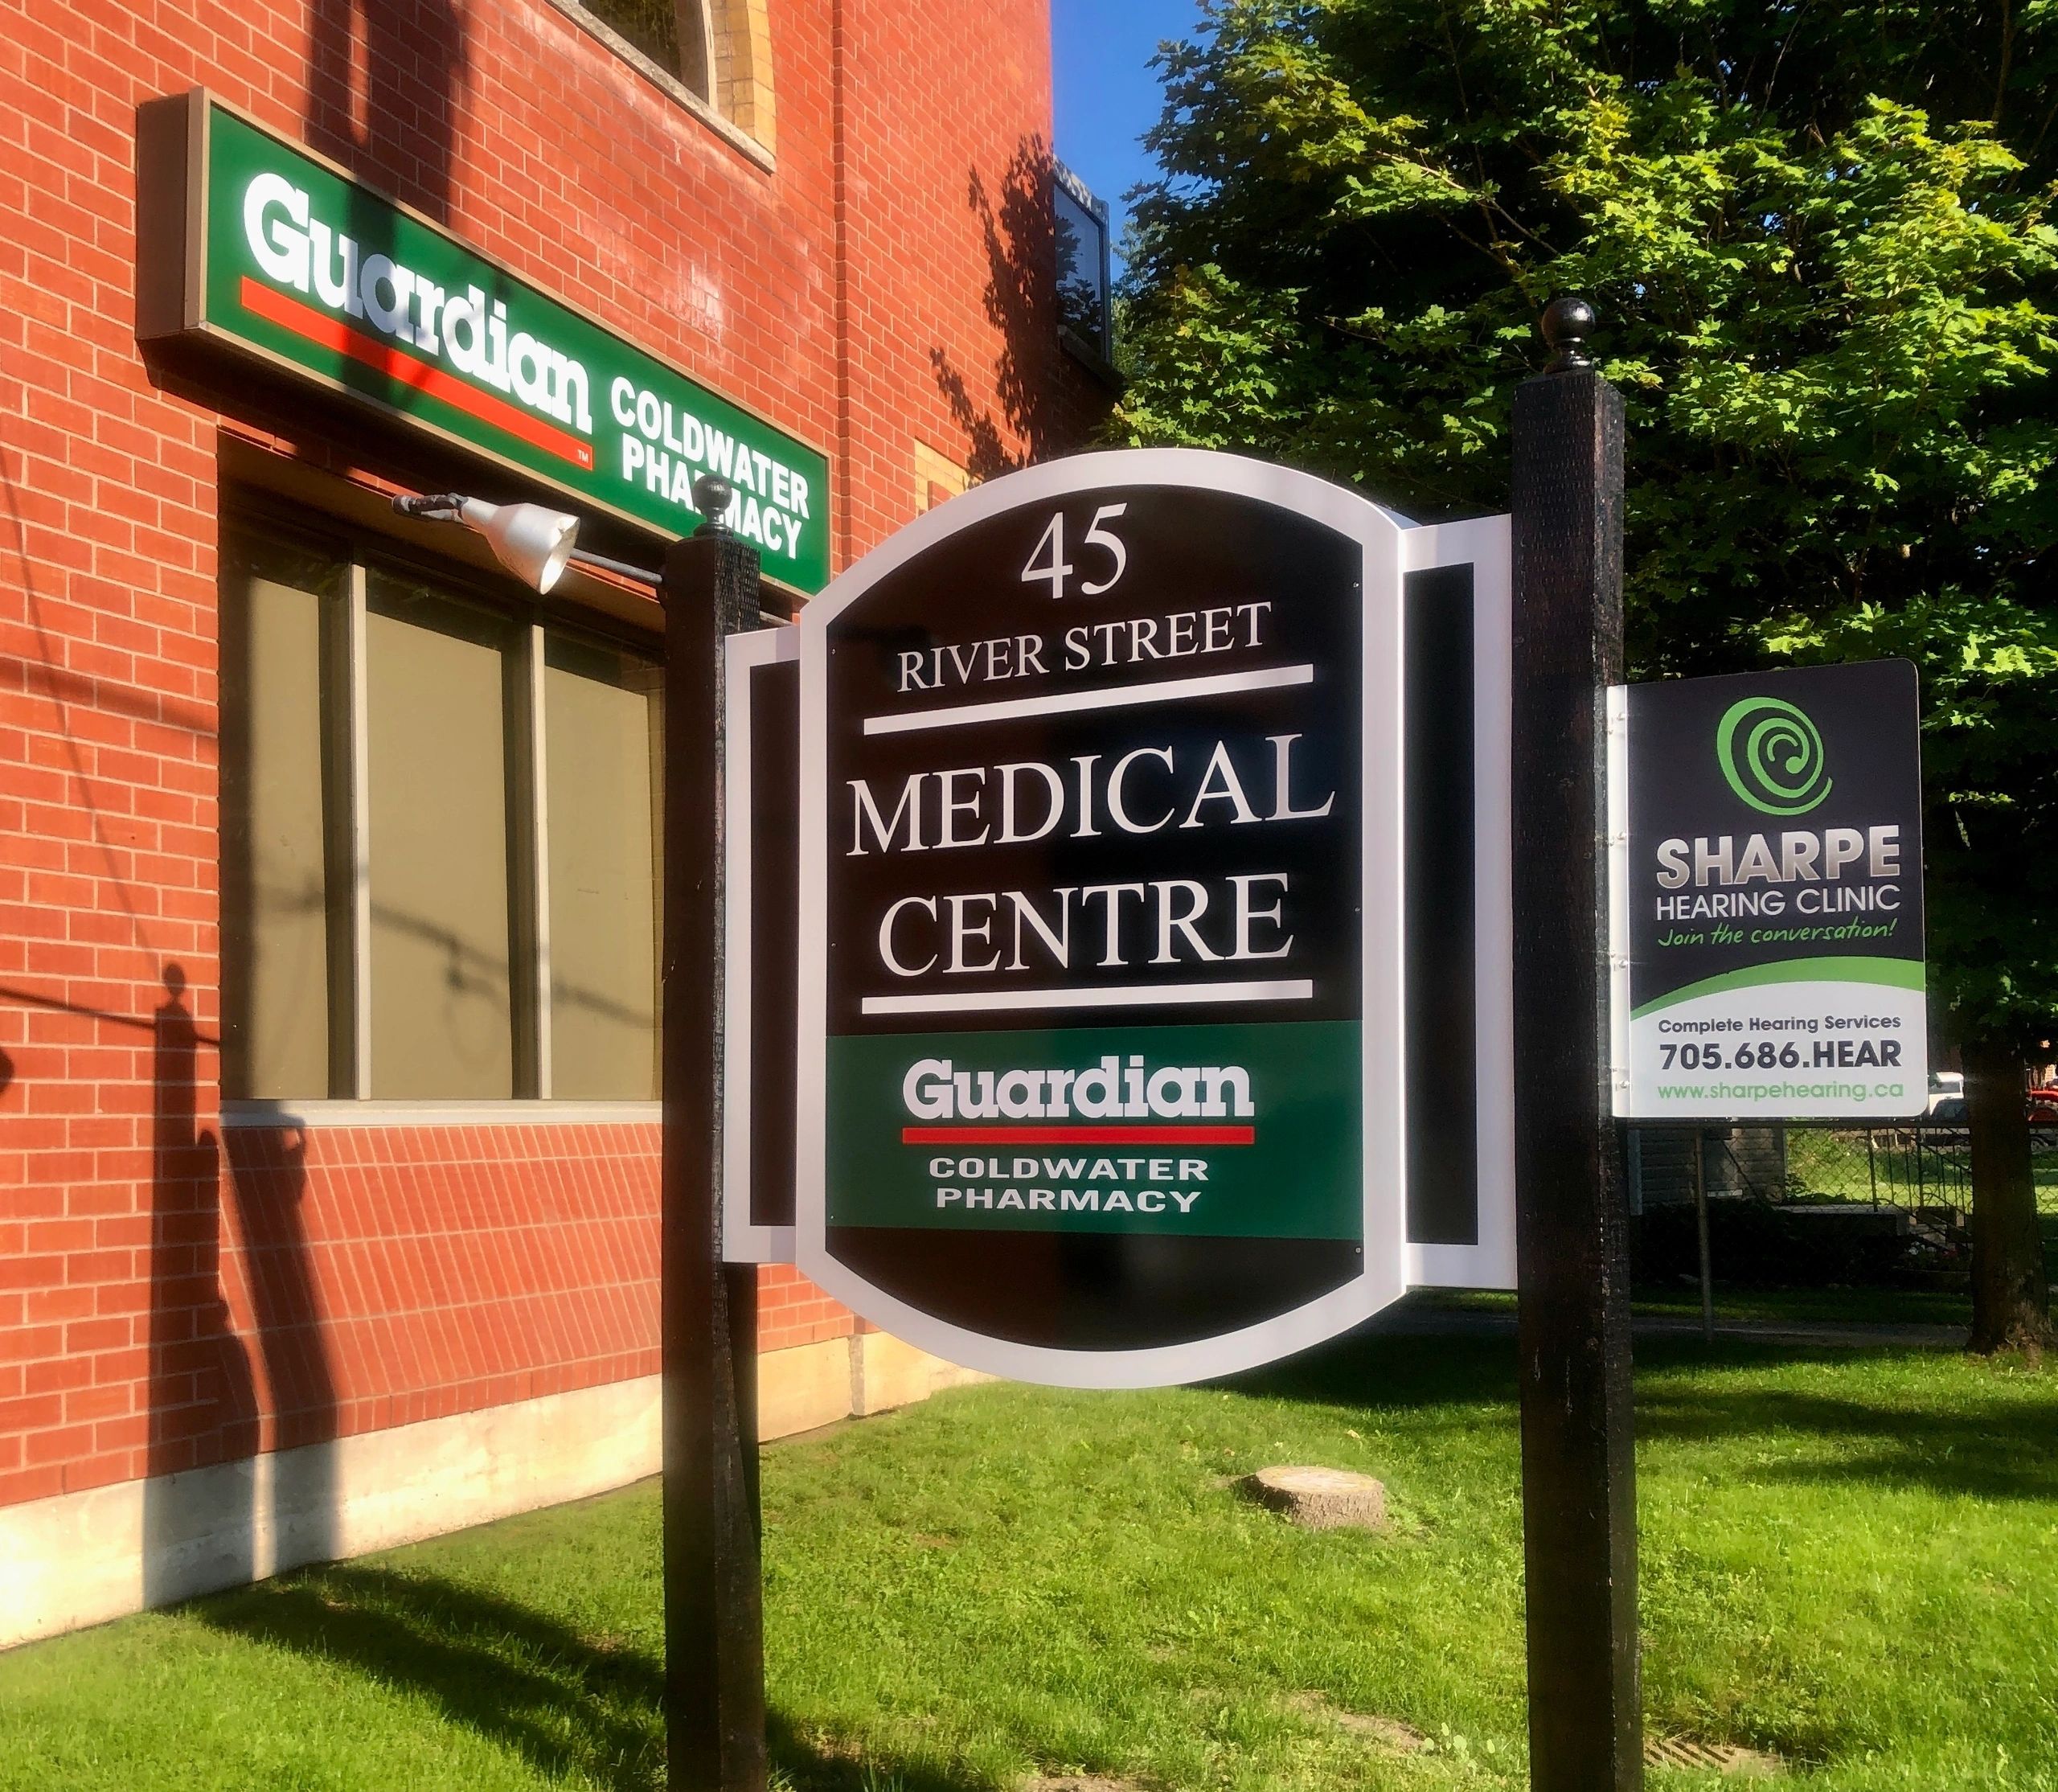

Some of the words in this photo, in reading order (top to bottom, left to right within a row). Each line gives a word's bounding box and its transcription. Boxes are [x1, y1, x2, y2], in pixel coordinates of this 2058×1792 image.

[244, 172, 592, 435] Guardian
[611, 376, 810, 519] COLDWATER
[622, 433, 802, 560] PHAMACY
[1021, 502, 1127, 599] 45
[896, 634, 1049, 692] RIVER
[1064, 601, 1272, 671] STREET
[846, 733, 1335, 855] MEDICAL
[1656, 825, 1900, 889] SHARPE
[879, 872, 1294, 977] CENTRE
[1656, 890, 1785, 921] HEARING
[1796, 884, 1901, 913] CLINIC
[1658, 928, 1704, 947] Join
[1711, 921, 1744, 945] the
[1750, 916, 1898, 943] conversation!
[1658, 1018, 1744, 1035] Complete
[1749, 1016, 1818, 1033] Hearing
[1824, 1015, 1902, 1030] Services
[1659, 1040, 1902, 1070] 705.686.HEAR
[902, 1055, 1255, 1120] Guardian
[1658, 1081, 1904, 1102] www.sharpehearing.ca
[929, 1158, 1209, 1181] COLDWATER
[937, 1187, 1202, 1213] PHARMACY
